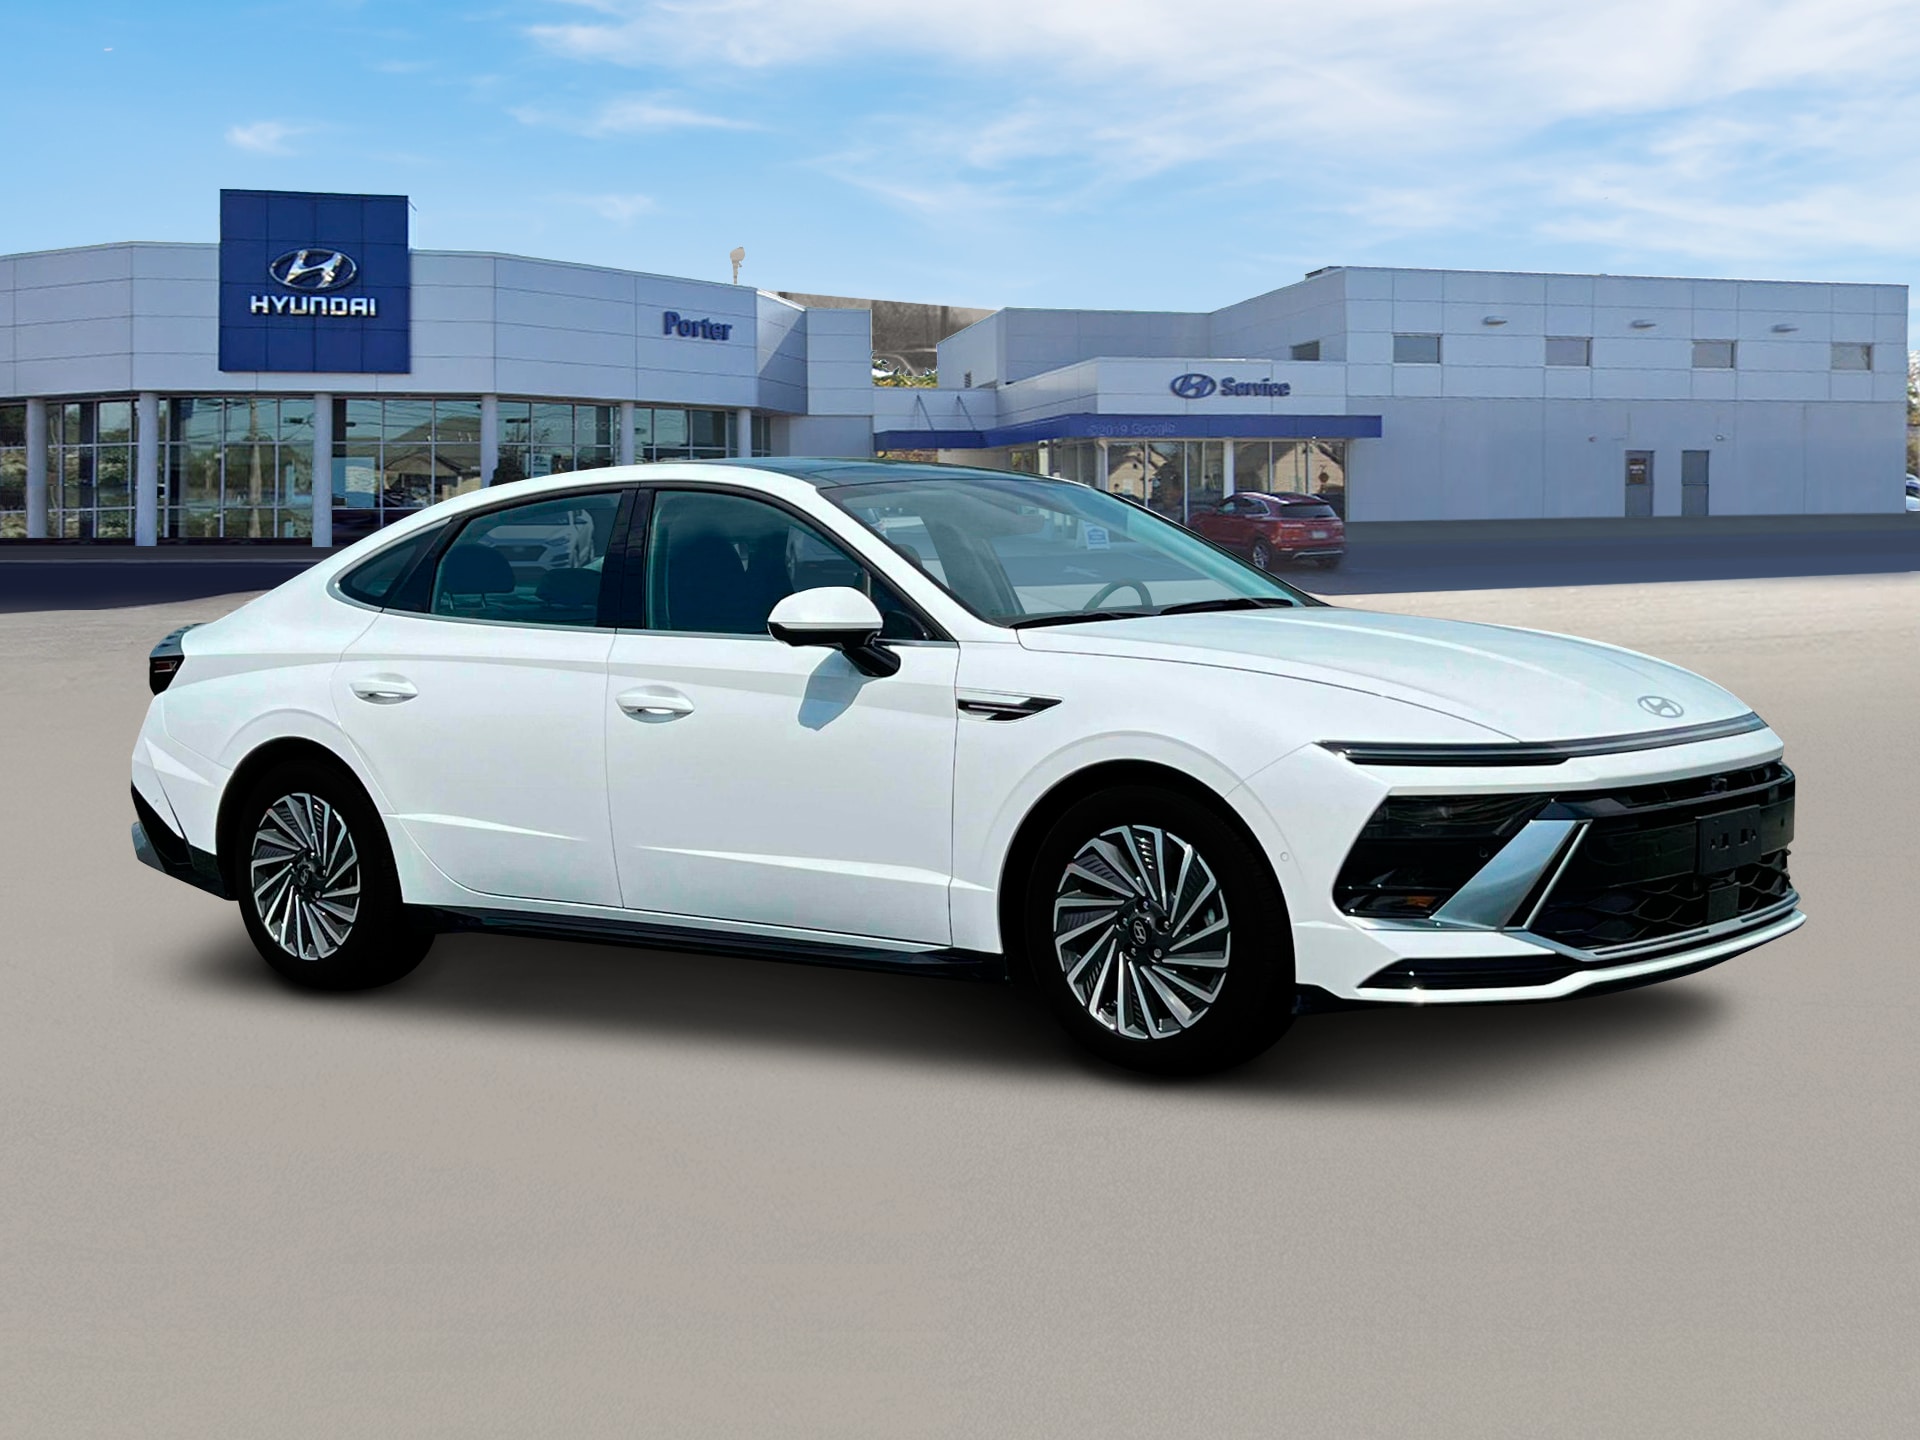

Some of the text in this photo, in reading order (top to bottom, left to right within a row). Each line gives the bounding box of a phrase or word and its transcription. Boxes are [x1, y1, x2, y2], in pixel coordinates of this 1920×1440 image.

[250, 295, 377, 316] HYUNDAI
[663, 311, 732, 340] Porter
[1220, 377, 1291, 396] Service
